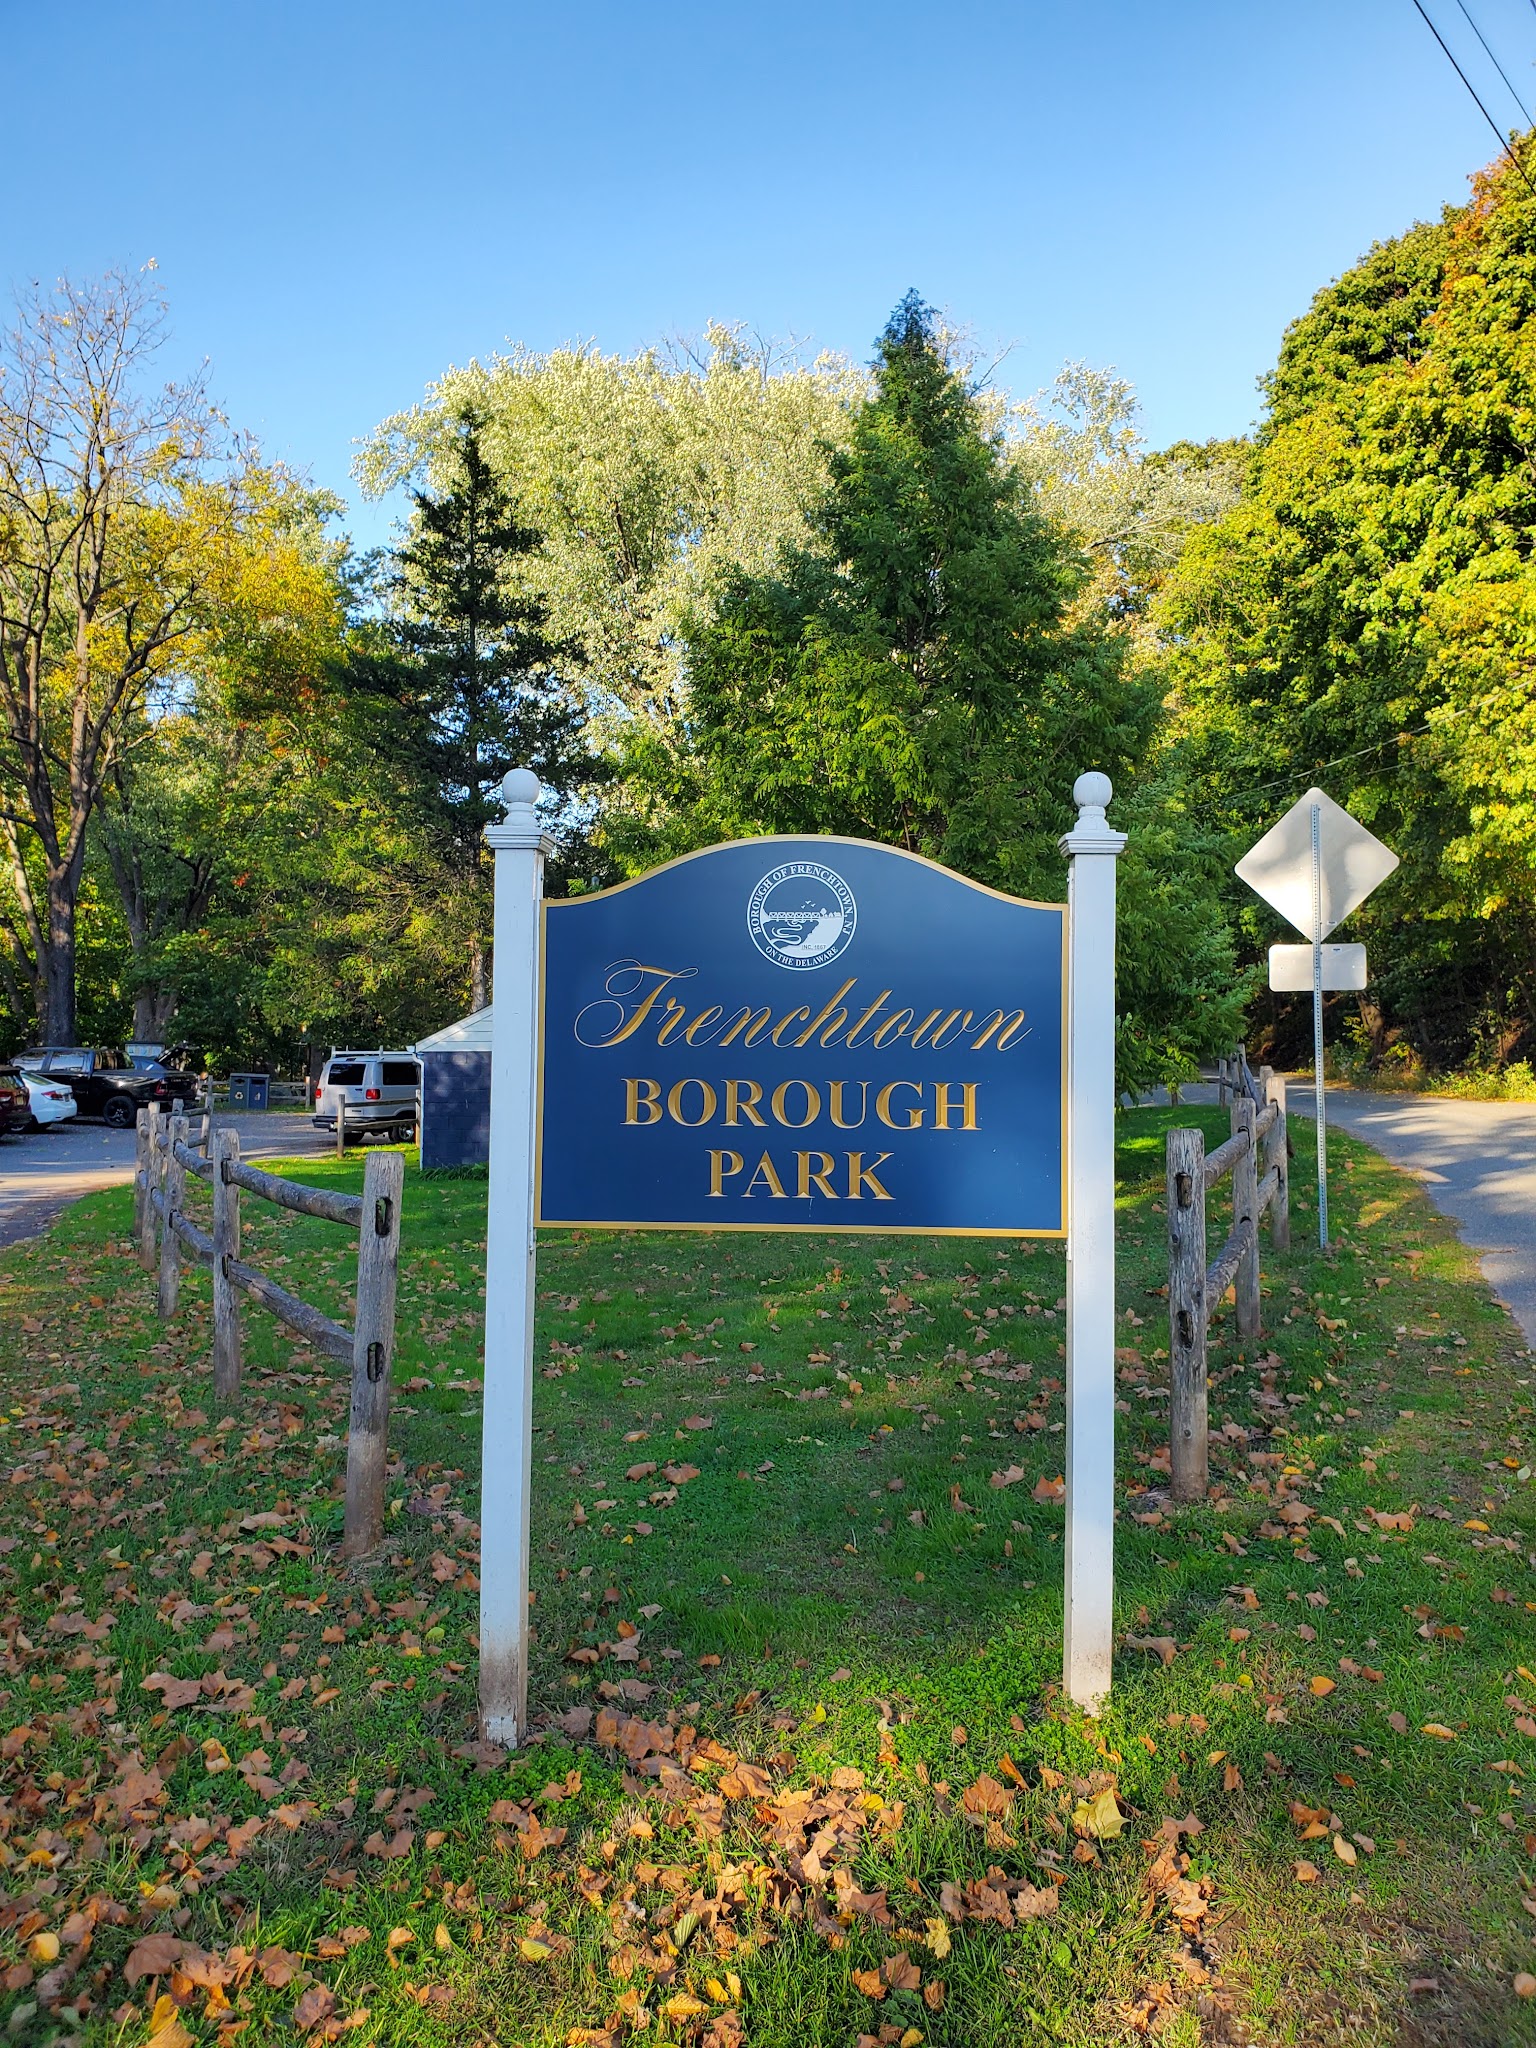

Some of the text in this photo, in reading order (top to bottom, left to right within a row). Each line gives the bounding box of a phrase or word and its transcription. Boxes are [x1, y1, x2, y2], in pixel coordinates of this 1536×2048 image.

[751, 880, 773, 934] BOROUGH
[772, 869, 788, 881] OF
[842, 921, 853, 935] NJ
[765, 946, 839, 967] ON THE DELAWARE
[573, 957, 1033, 1052] Frenchtown
[620, 1078, 982, 1131] BOROUGH
[704, 1149, 896, 1200] PARK
